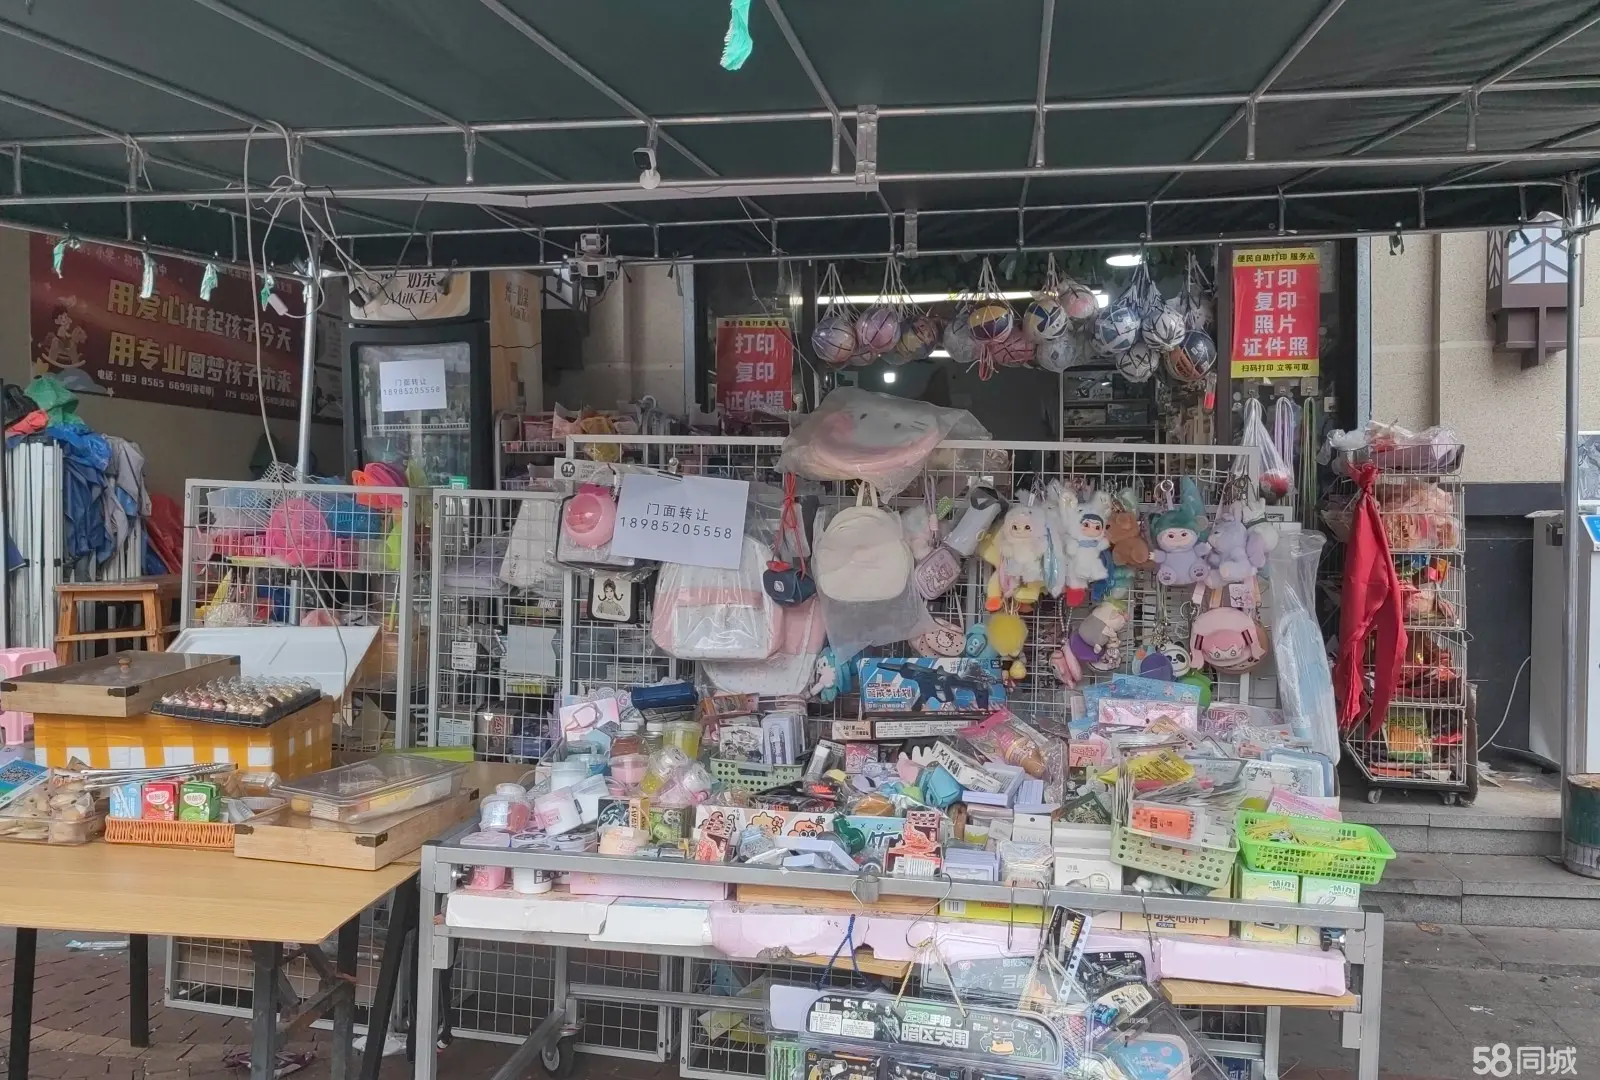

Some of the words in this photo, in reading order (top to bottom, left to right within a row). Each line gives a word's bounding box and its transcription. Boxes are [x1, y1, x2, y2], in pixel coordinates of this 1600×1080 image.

[1237, 253, 1288, 263] 便民自助打印
[1290, 252, 1316, 261] 服务点
[1254, 268, 1297, 289] 打印
[1254, 291, 1297, 312] 复印
[107, 279, 292, 352] 用爱心托起孩子今天
[1254, 313, 1297, 334] 照片
[735, 332, 775, 355] 打印
[1242, 336, 1309, 357] 证件照
[108, 331, 292, 393] 用专业圆梦孩子未来
[735, 361, 776, 383] 复印
[1241, 364, 1275, 373] 扫码打印
[1276, 362, 1310, 372] 立等可取
[383, 386, 441, 396] 18985205558
[394, 378, 427, 386] 门面转让
[646, 502, 709, 522] 门面转让
[620, 516, 732, 539] 18985205558
[1272, 879, 1295, 889] Mini
[1333, 885, 1356, 895] Mini
[903, 1009, 952, 1028] 左轮手枪
[901, 1022, 969, 1049] 暗区突围
